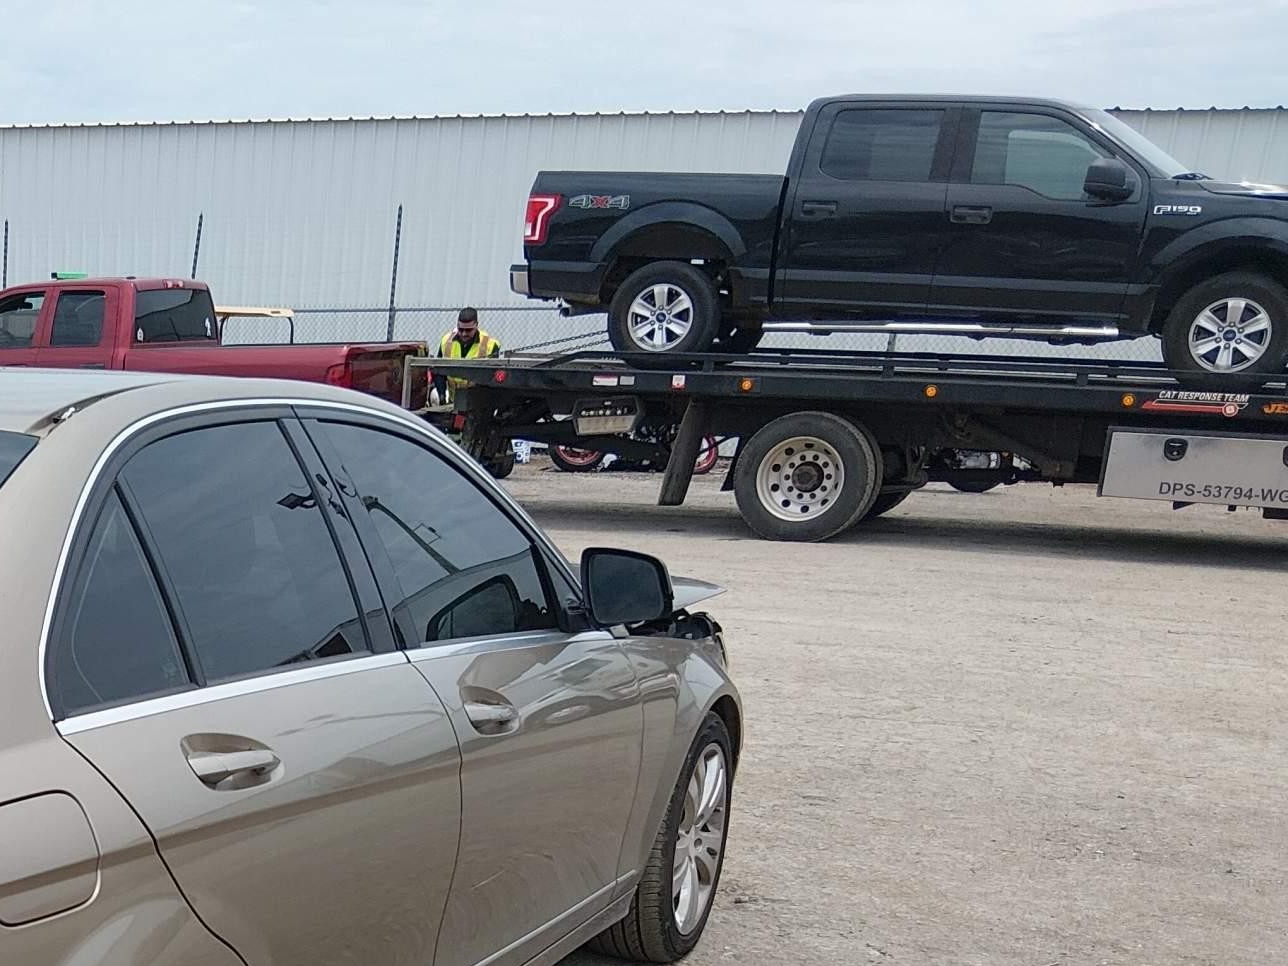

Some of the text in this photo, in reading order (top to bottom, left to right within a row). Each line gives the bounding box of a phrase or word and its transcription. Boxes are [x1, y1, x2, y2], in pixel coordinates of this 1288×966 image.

[1159, 390, 1250, 403] CAT RESPONSE TEAM
